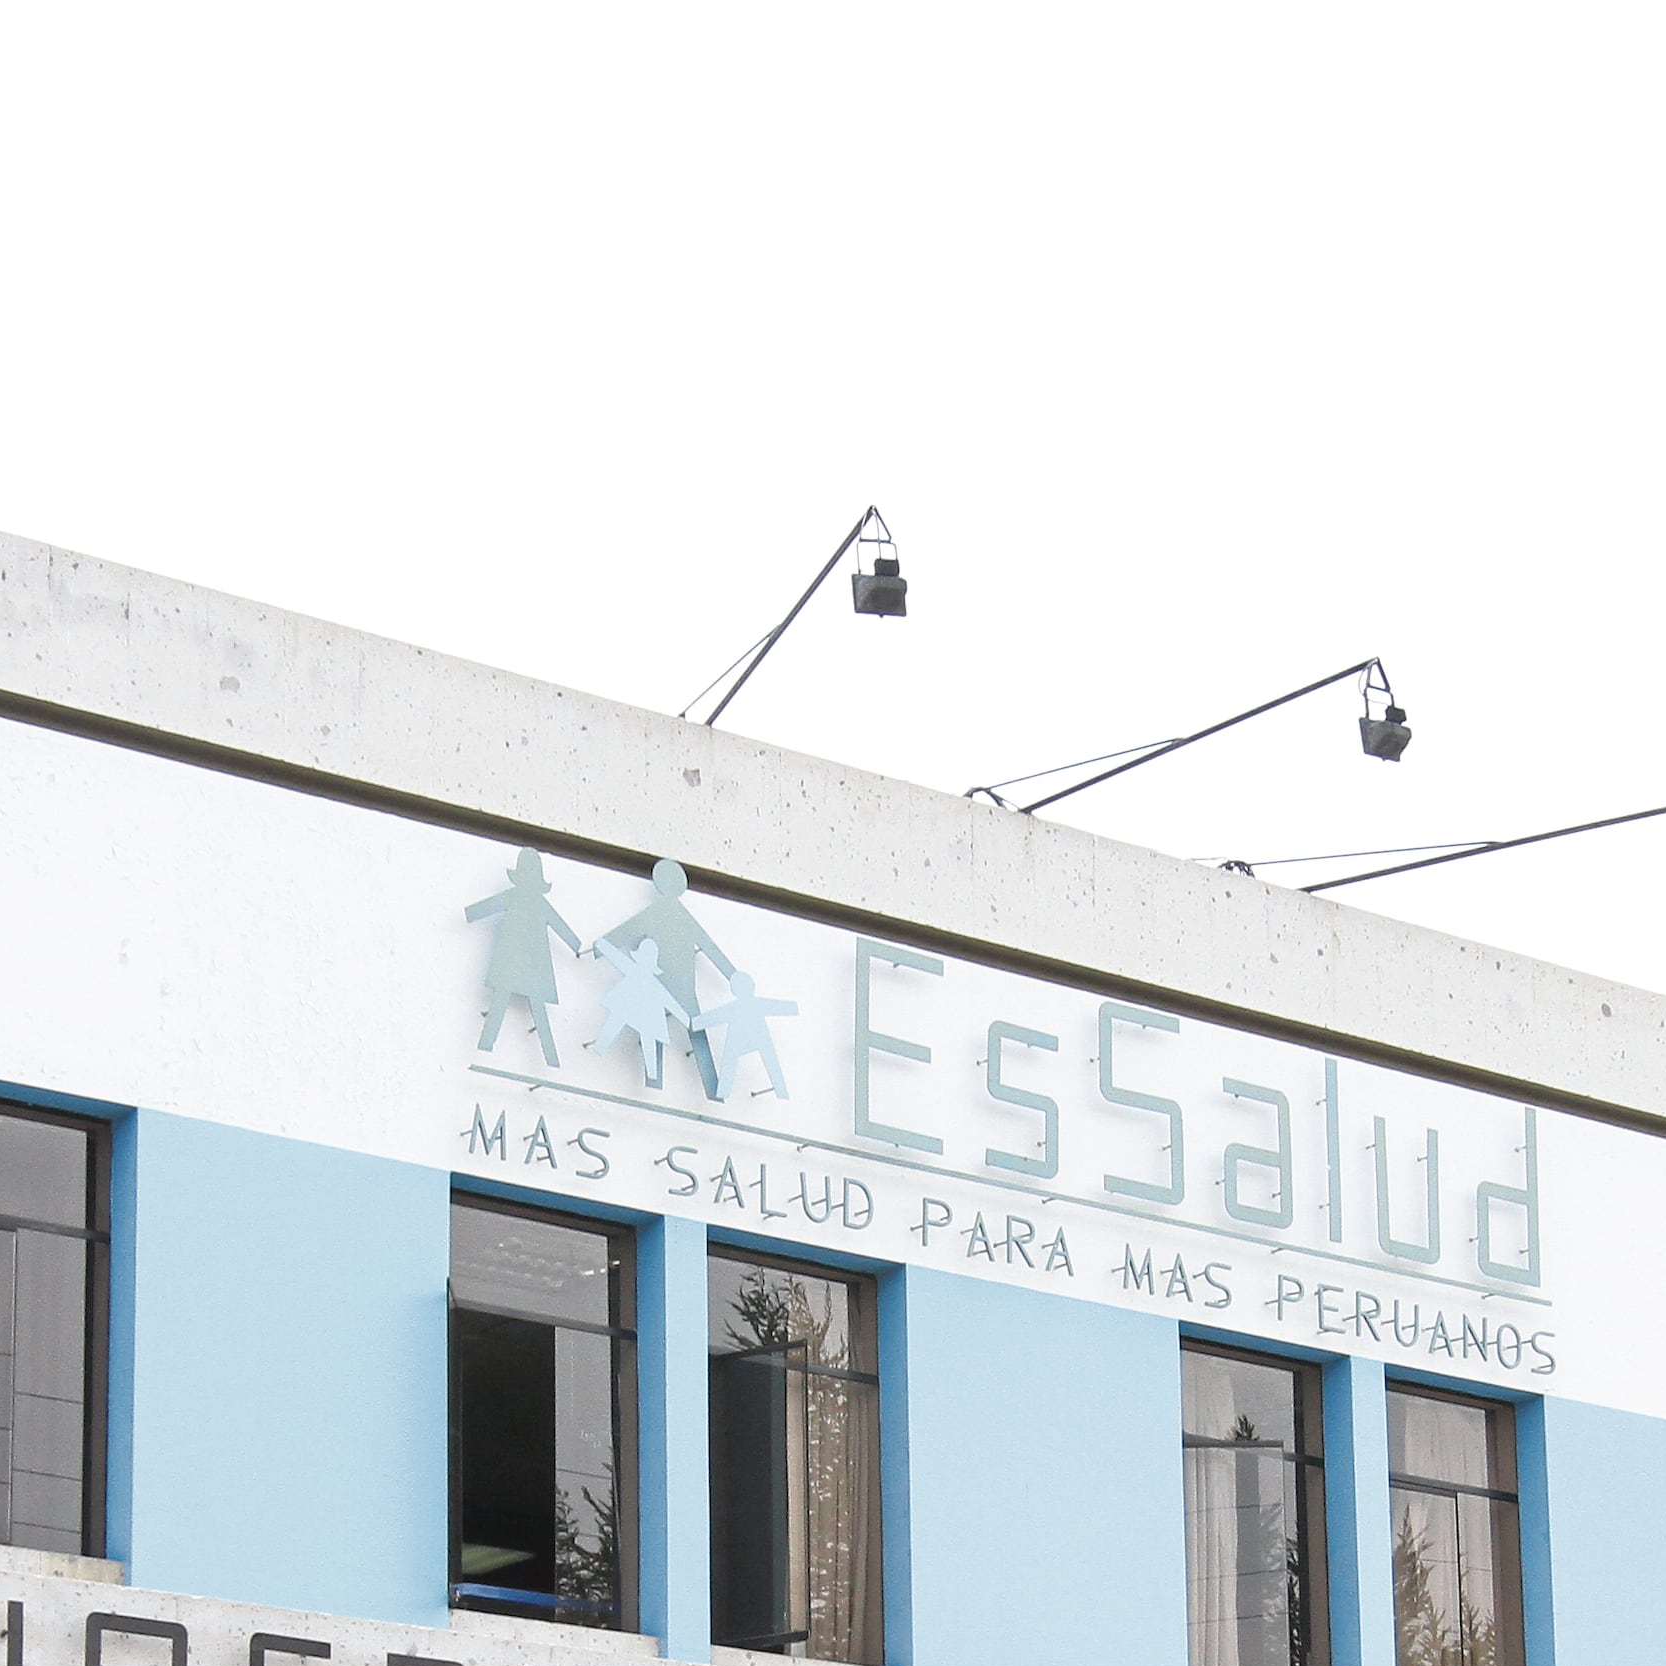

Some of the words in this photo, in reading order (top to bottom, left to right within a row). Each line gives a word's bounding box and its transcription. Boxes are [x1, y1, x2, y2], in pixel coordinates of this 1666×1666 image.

[467, 1103, 611, 1182] MAS
[665, 1145, 875, 1232] SALUD
[921, 1197, 1075, 1279] PARA
[1121, 1242, 1236, 1311] MAS
[1277, 1273, 1559, 1375] PERUANOS
[854, 936, 1543, 1289] EsSalud
